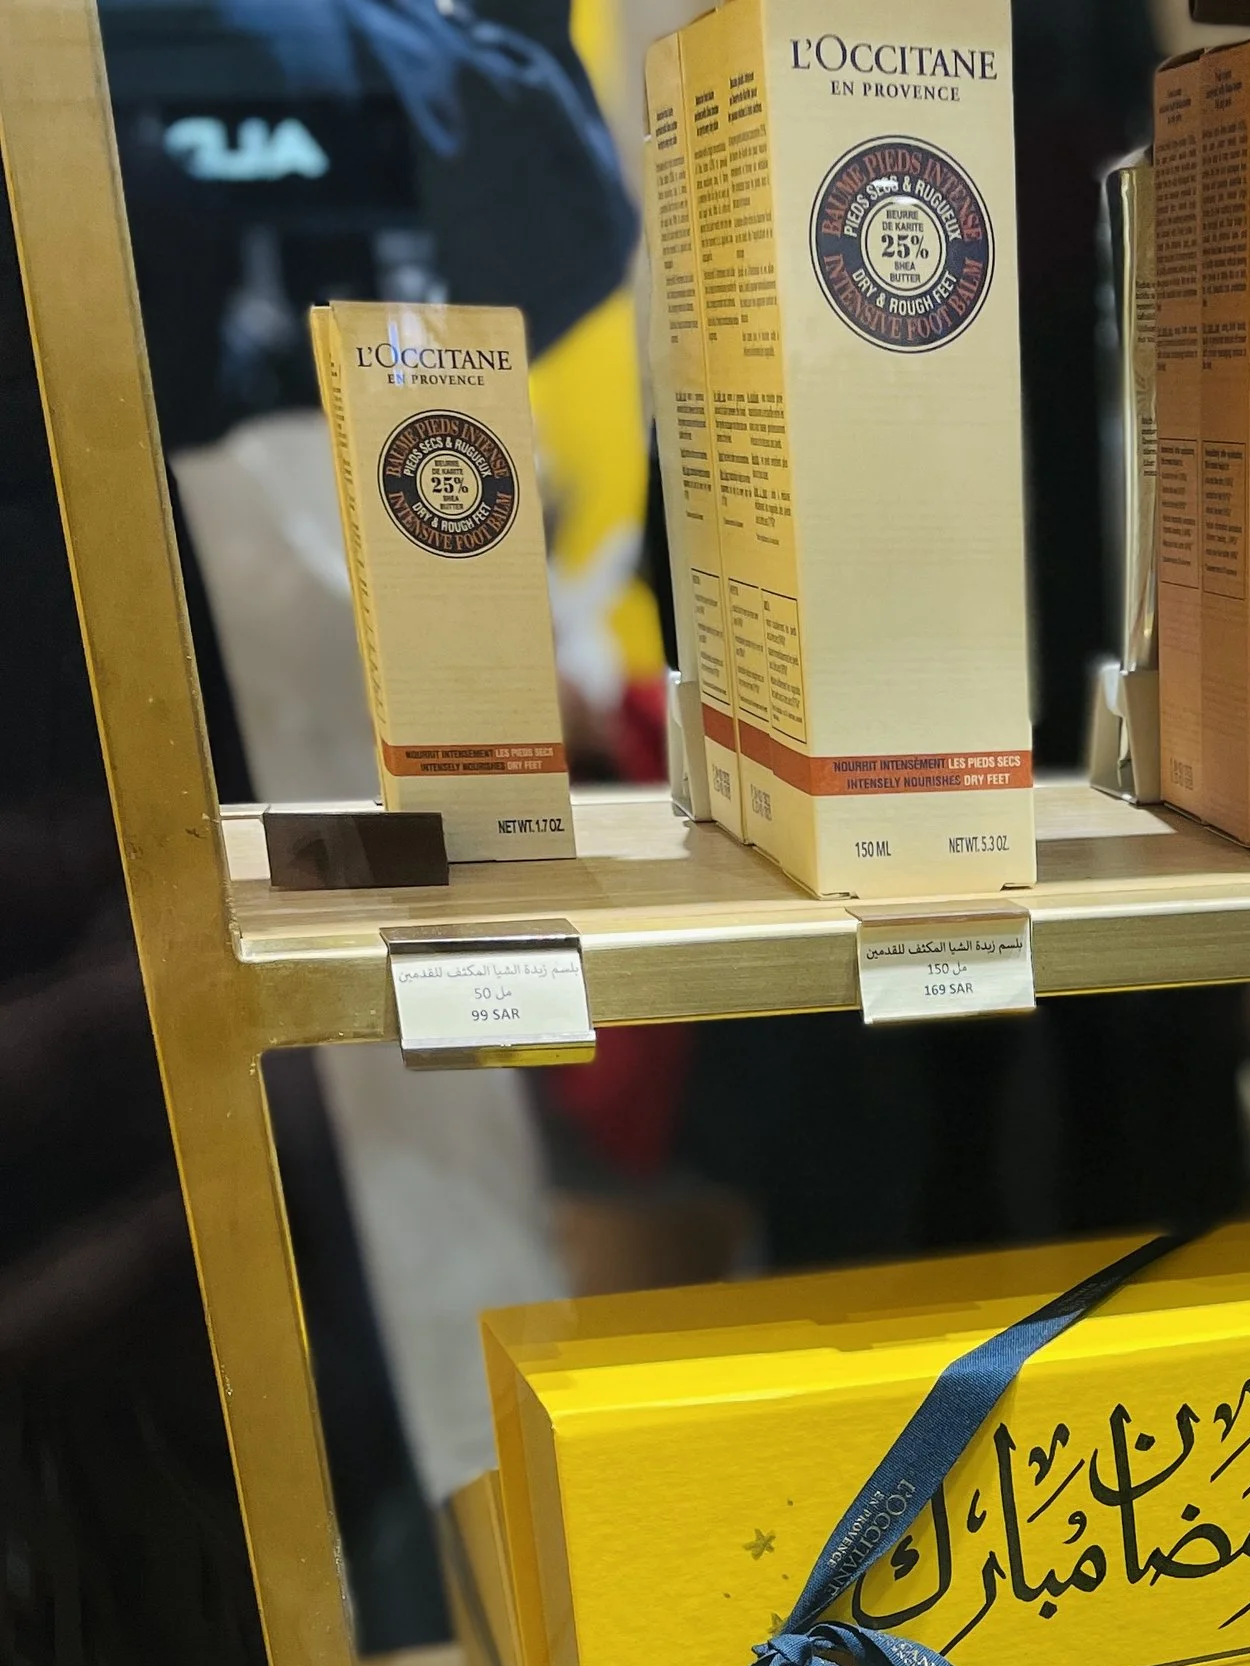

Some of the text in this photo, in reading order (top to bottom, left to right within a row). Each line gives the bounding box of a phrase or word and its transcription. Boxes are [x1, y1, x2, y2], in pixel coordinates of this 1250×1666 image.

[791, 34, 998, 79] L'OCCITANE
[831, 80, 960, 101] EN PROVENCE
[820, 149, 983, 243] BAUME PIEDS INTENSE
[843, 194, 870, 238] PIEDS
[902, 176, 911, 191] &
[916, 179, 962, 241] RUGUEUX
[881, 234, 929, 259] 25%
[824, 253, 983, 342] INTENSIVE FOOT BALM
[852, 268, 958, 315] DRY & ROUGH FEET
[357, 343, 512, 370] L'OCCITANE
[412, 374, 484, 385] PROVENCE
[432, 477, 469, 493] 25%
[833, 761, 877, 772] NOURRIT
[948, 759, 965, 769] LES
[968, 757, 994, 768] PIEDS
[998, 756, 1020, 767] SECS
[847, 774, 1009, 789] INTENSELY NOURISHES DRY FEET
[498, 819, 547, 833] NET WT. 1.7
[856, 837, 994, 858] 150 ML NET WT. 5.3
[867, 944, 904, 959] للقدمين
[908, 942, 945, 955] المكثف
[949, 942, 972, 955] الشيا
[999, 938, 1022, 954] بلسم
[928, 962, 967, 975] مل 150
[925, 983, 973, 995] 169 SAR
[472, 1008, 520, 1021] 99 SAR
[829, 1491, 884, 1568] EN PROVENCE
